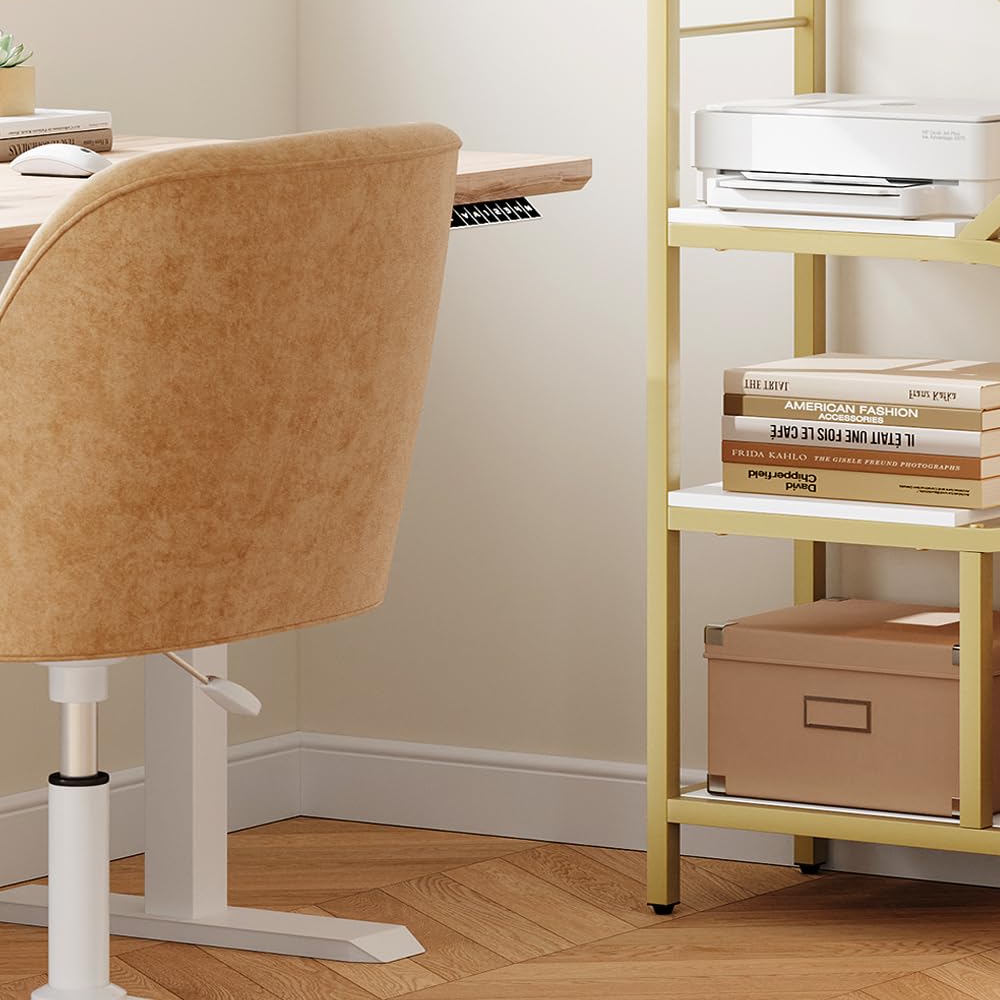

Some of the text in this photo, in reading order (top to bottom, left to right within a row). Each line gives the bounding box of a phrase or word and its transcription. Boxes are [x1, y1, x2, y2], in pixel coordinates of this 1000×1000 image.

[784, 401, 918, 418] AMERICAN FASHION
[818, 413, 884, 424] ACCESSORIES
[770, 425, 915, 449] IL ÉTAIT UNE FOIS LE CAFÉ
[731, 449, 765, 461] FRIDA
[768, 451, 808, 461] KAHLO
[832, 456, 861, 464] GISELE
[865, 458, 899, 466] FREUND
[900, 460, 960, 471] PHOTOGRAPHS
[748, 470, 817, 483] Chipperfield
[785, 482, 817, 493] David
